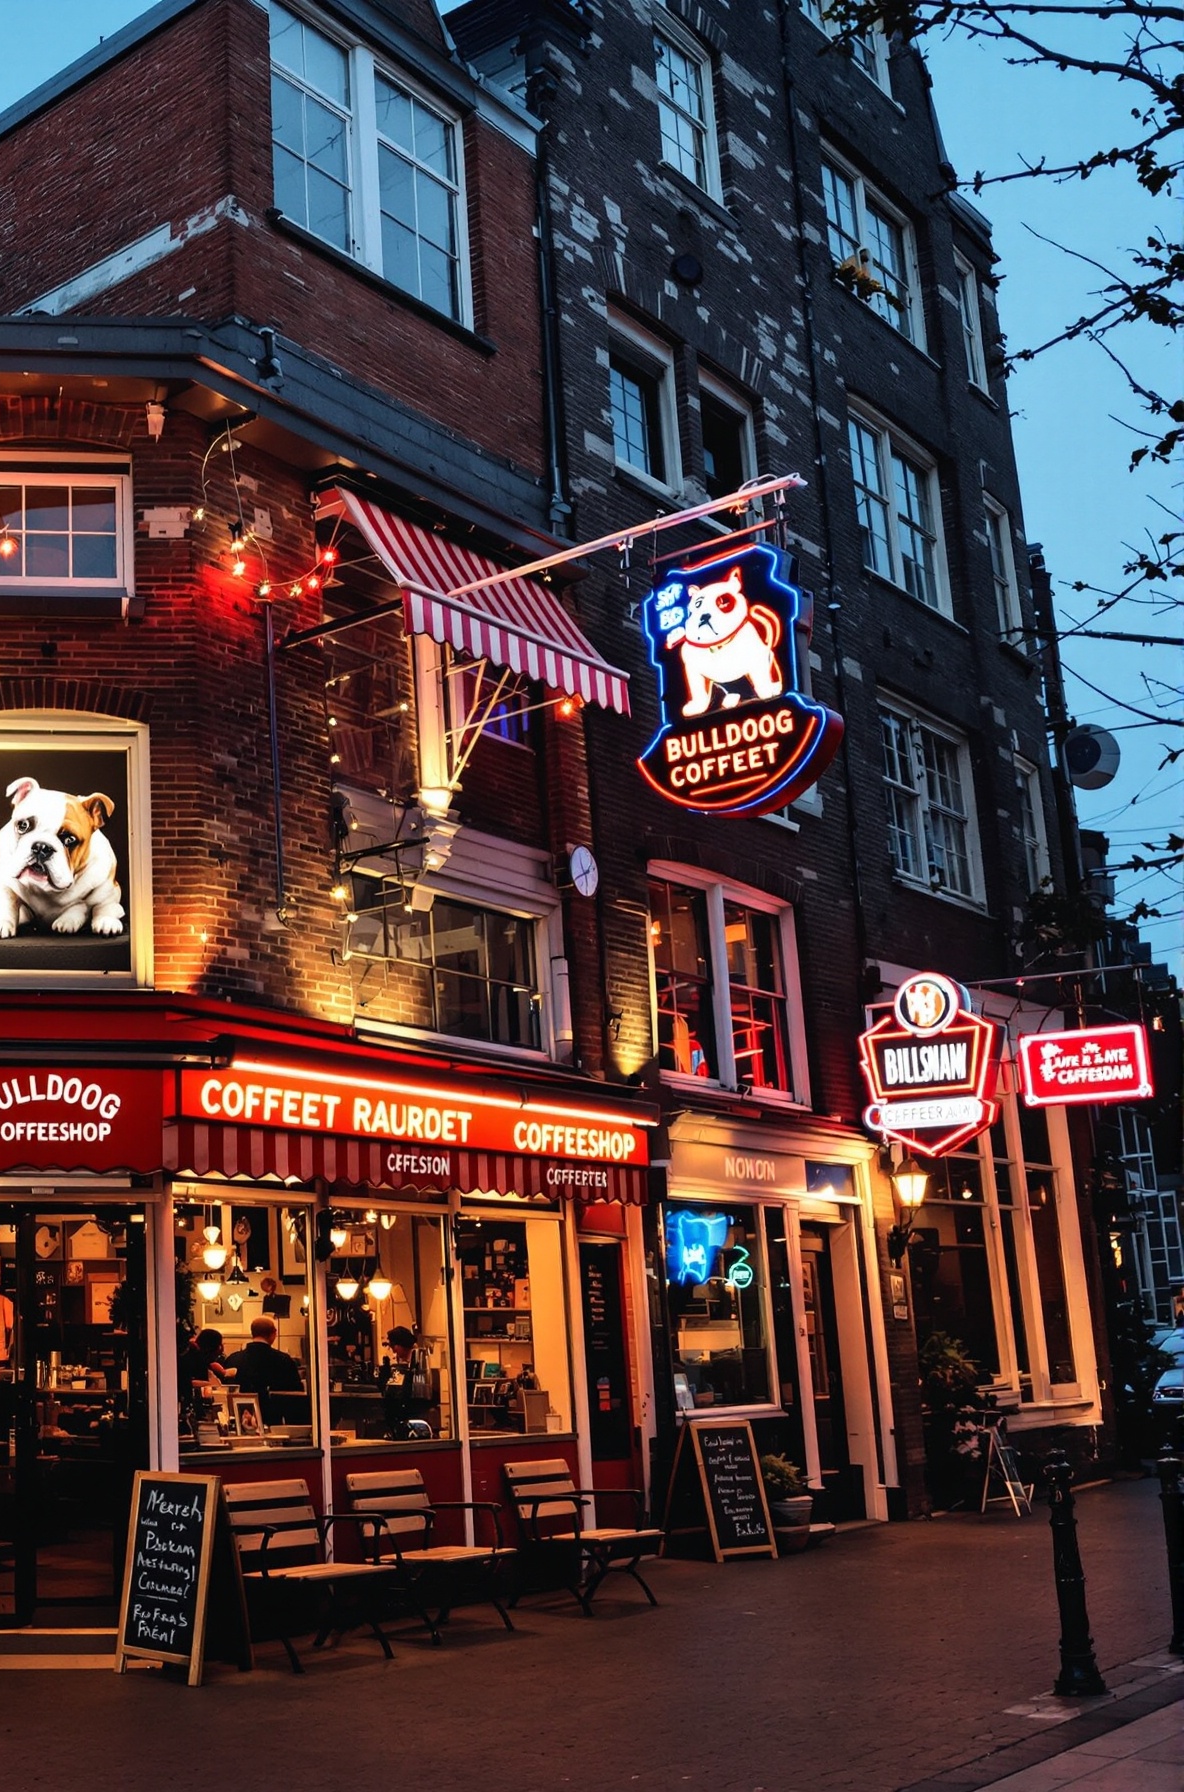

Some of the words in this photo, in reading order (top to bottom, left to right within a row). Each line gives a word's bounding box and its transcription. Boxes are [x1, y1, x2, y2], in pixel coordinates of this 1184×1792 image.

[666, 709, 794, 763] BULLDOOG
[670, 742, 779, 787] COFFEET
[200, 1078, 342, 1129] COFFEET
[353, 1098, 472, 1144] RAURDET
[513, 1120, 636, 1161] COFFEESHOP
